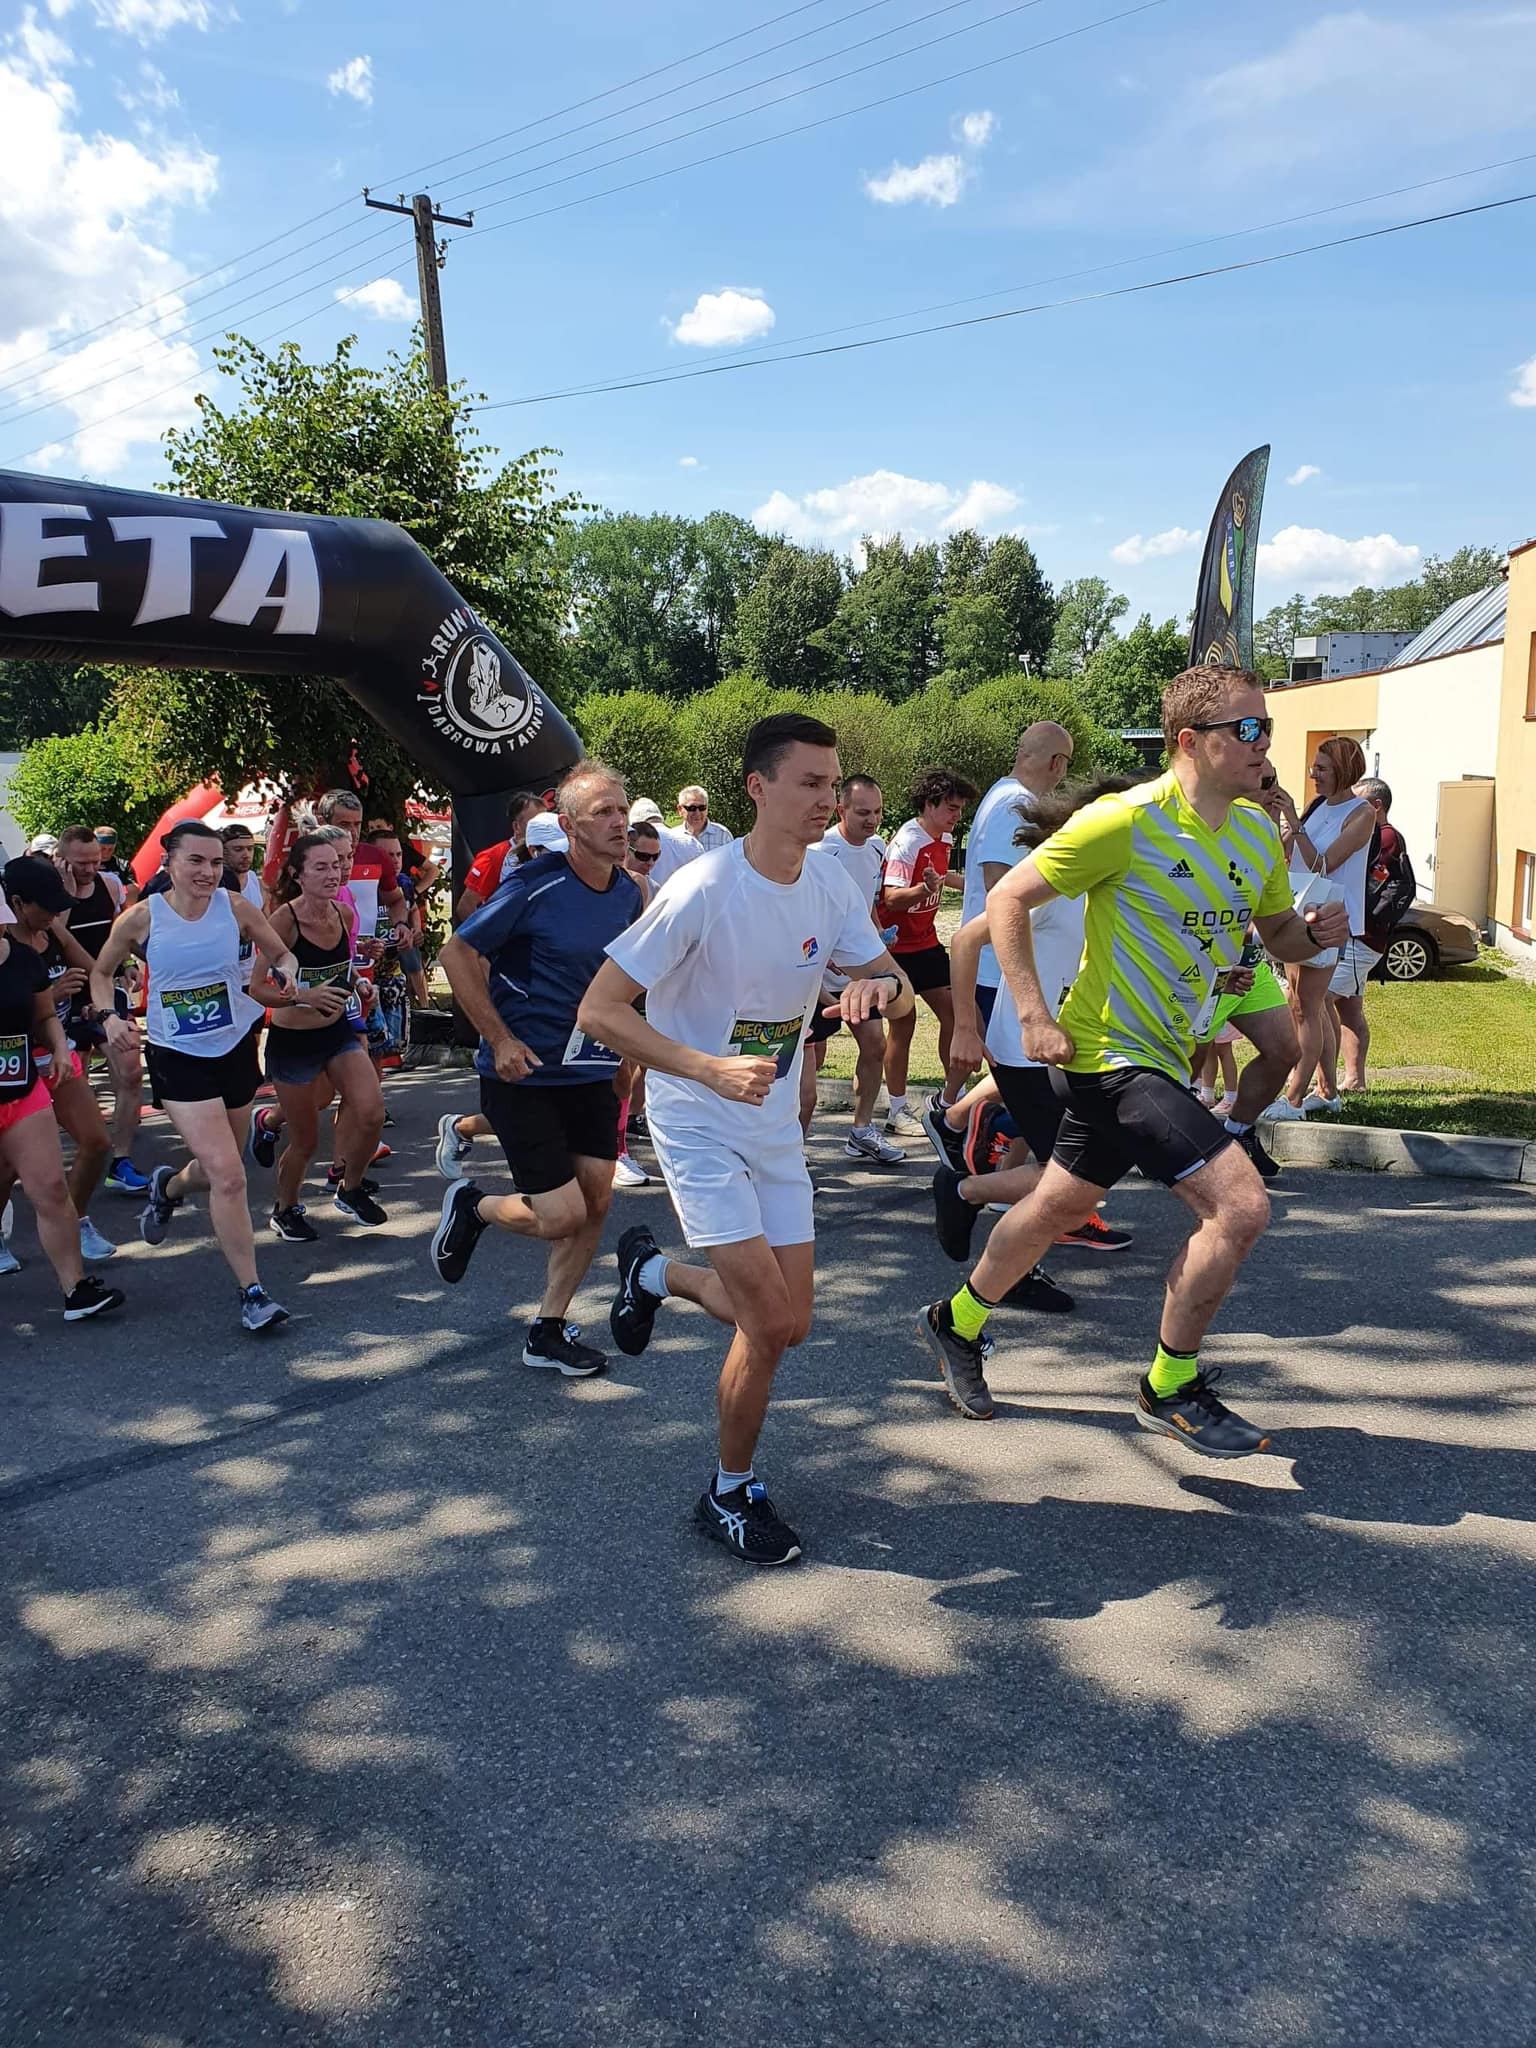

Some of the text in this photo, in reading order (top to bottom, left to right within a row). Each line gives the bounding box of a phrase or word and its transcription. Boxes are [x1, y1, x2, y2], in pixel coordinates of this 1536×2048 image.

[507, 674, 544, 751] TARNOW
[1183, 908, 1253, 926] BODO
[162, 992, 183, 1003] BIEG
[188, 1000, 222, 1025] 32
[734, 1023, 763, 1038] BIEG
